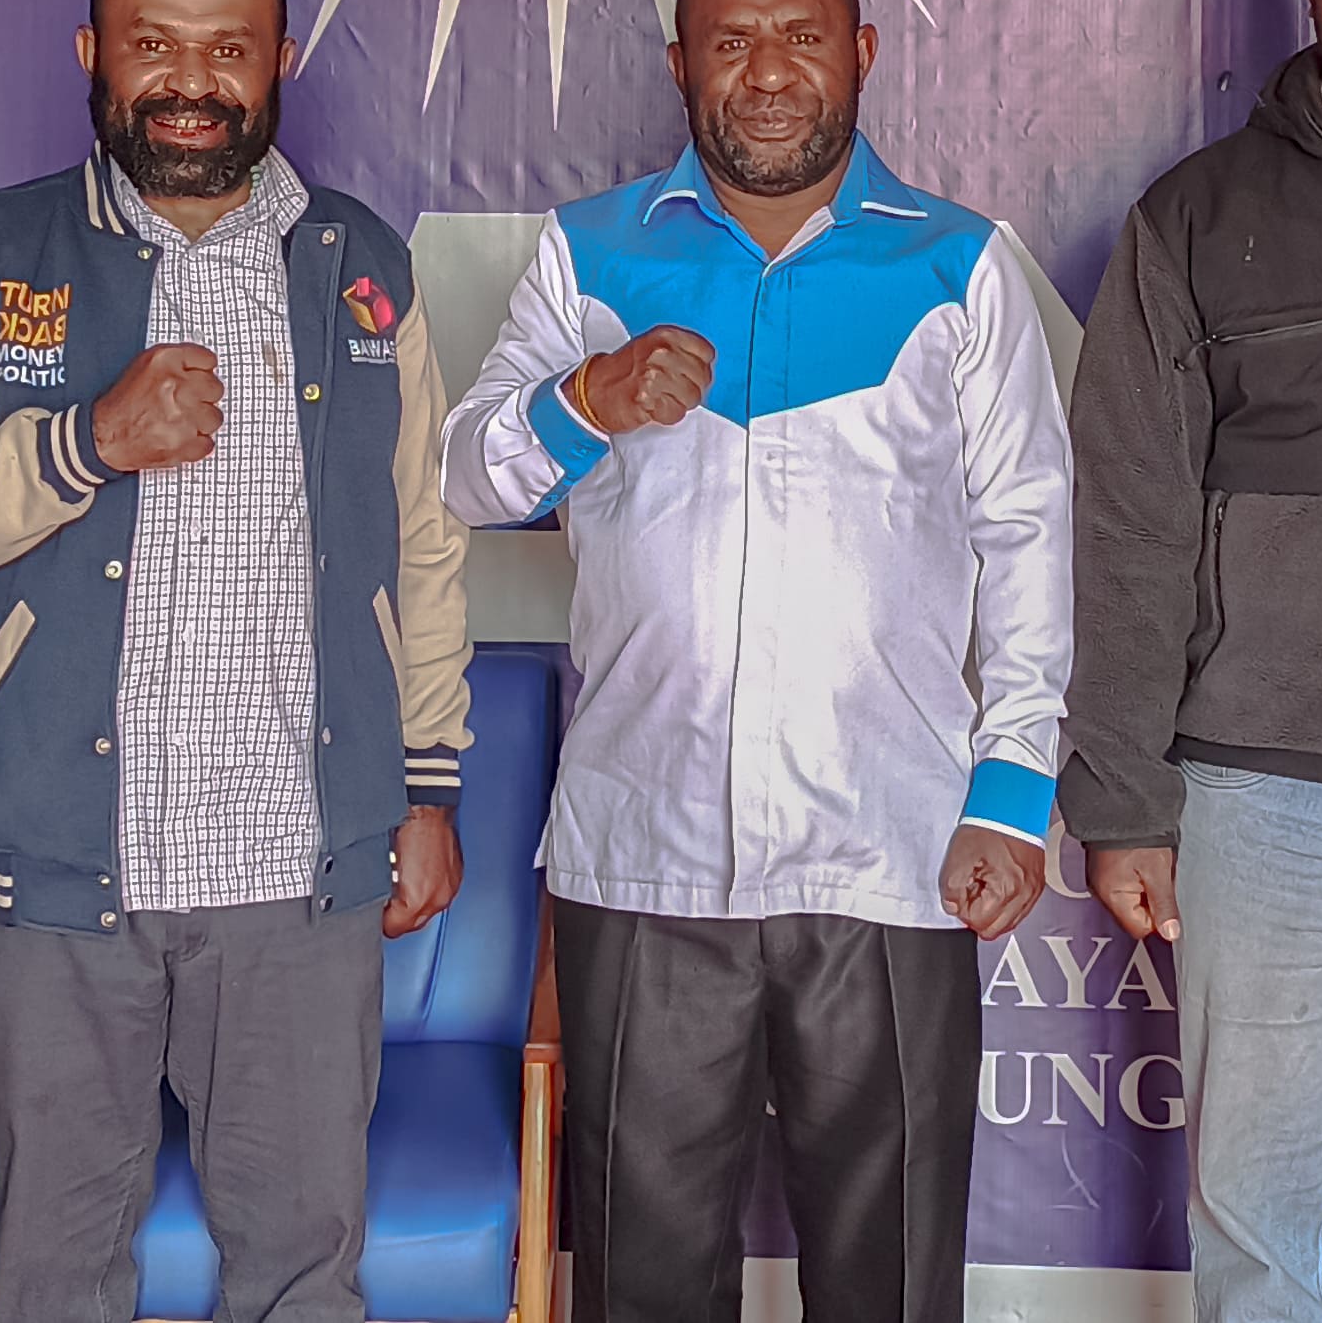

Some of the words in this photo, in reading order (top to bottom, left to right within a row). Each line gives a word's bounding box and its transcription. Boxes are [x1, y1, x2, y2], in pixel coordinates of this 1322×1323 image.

[0, 281, 70, 317] TURN
[348, 338, 396, 357] BAWAS
[981, 934, 1176, 1011] AYA
[978, 1051, 1185, 1129] UNG
